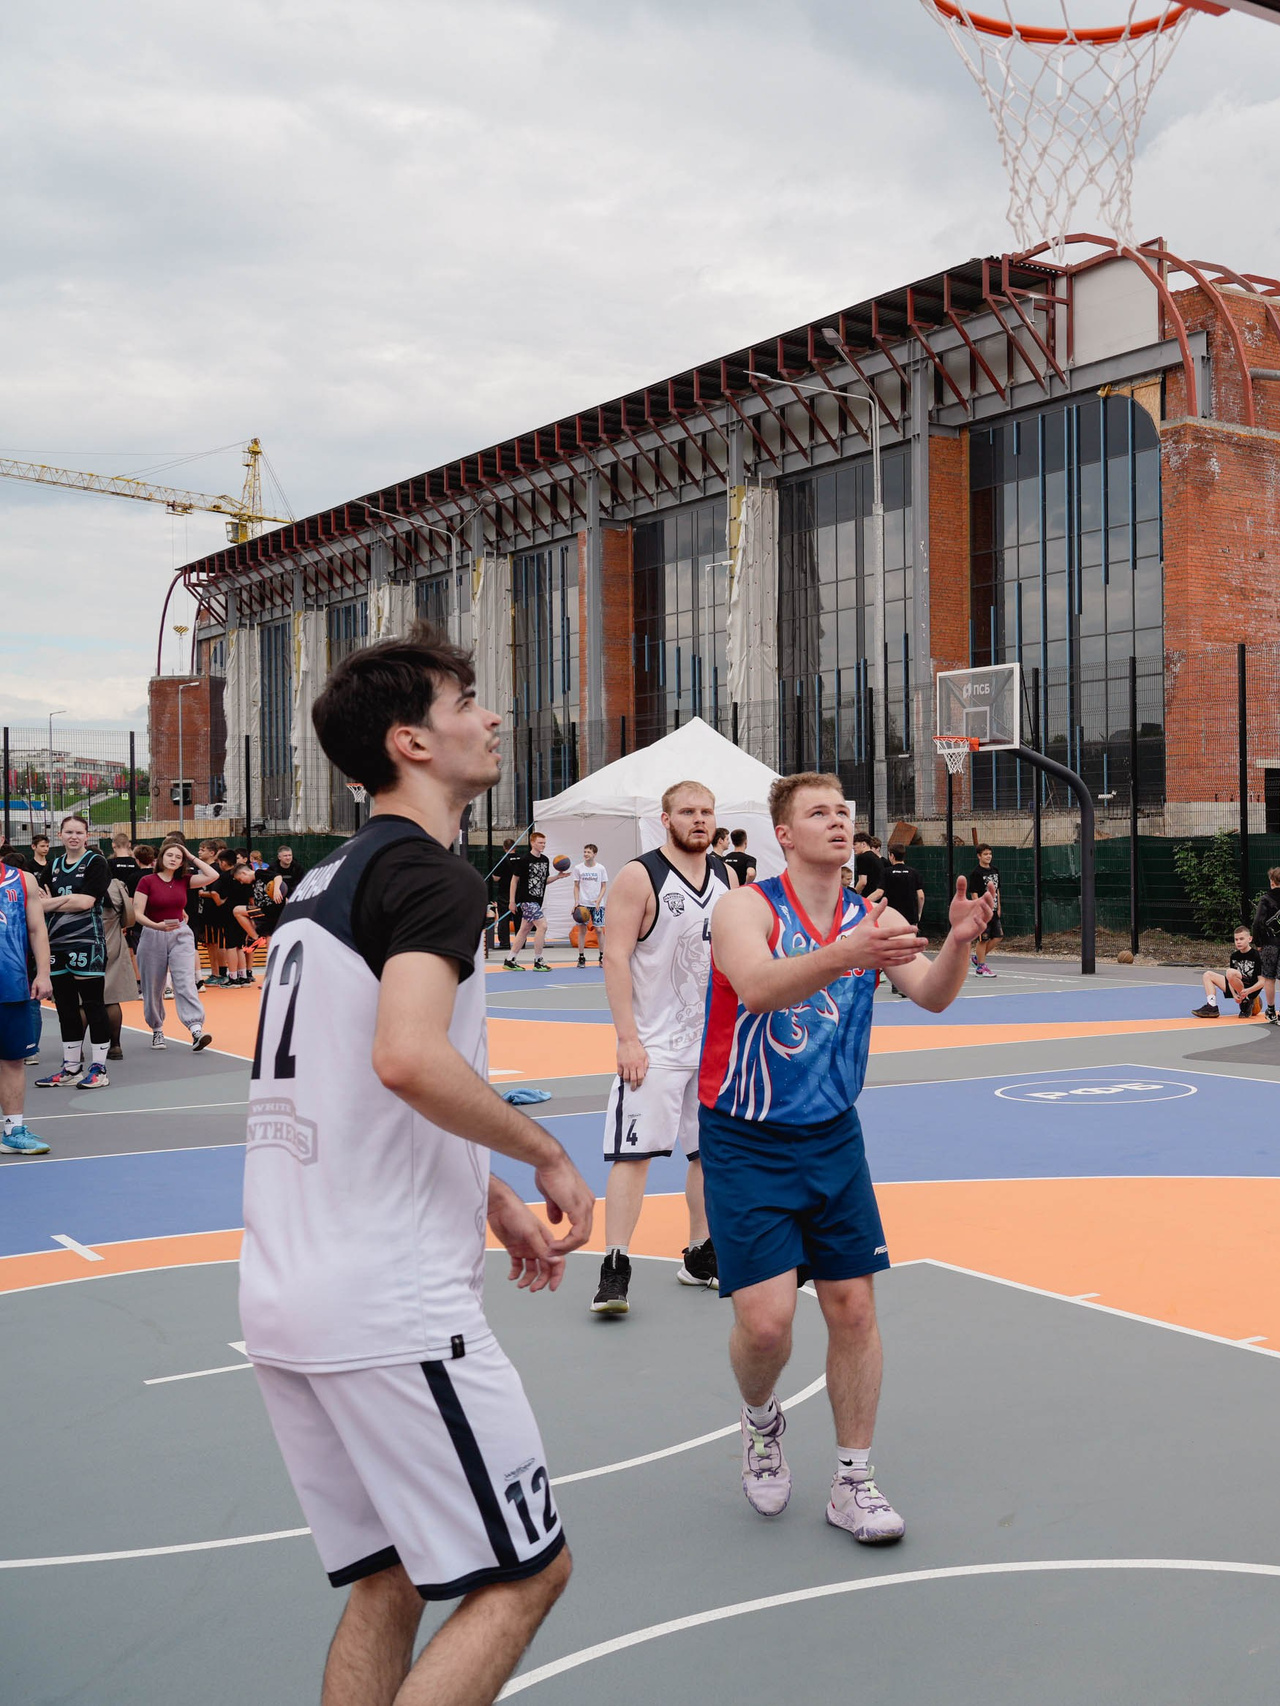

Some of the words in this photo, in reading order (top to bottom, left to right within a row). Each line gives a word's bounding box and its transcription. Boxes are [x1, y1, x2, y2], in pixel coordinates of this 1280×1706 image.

[973, 683, 990, 695] ПСБ
[5, 889, 18, 902] 11
[68, 952, 88, 967] 25
[251, 939, 304, 1079] 12
[626, 1119, 638, 1145] 4
[504, 1466, 558, 1545] 12
